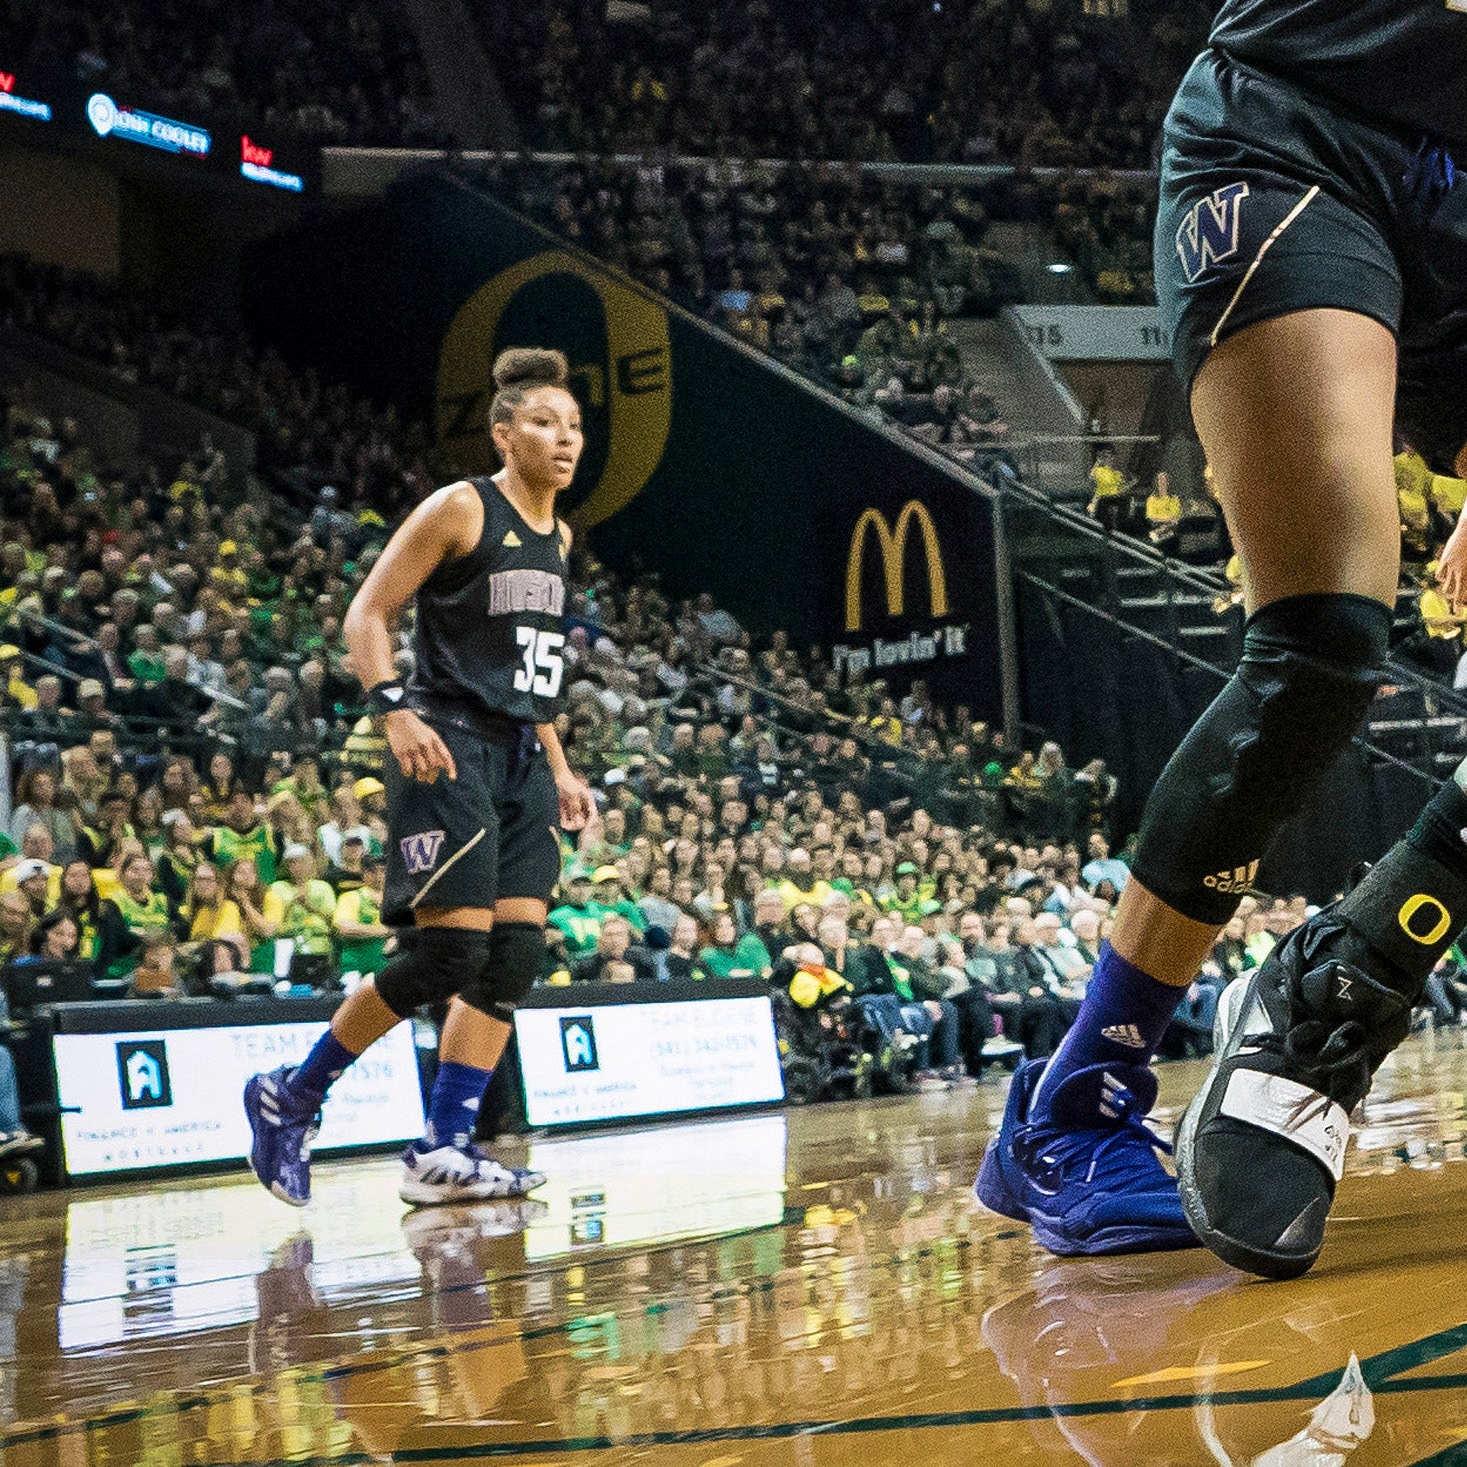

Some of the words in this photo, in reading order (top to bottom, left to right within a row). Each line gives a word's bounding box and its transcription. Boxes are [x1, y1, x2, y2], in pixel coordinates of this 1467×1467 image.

[1175, 181, 1250, 283] W
[513, 626, 565, 699] 35
[401, 830, 446, 875] W
[1398, 893, 1452, 945] O
